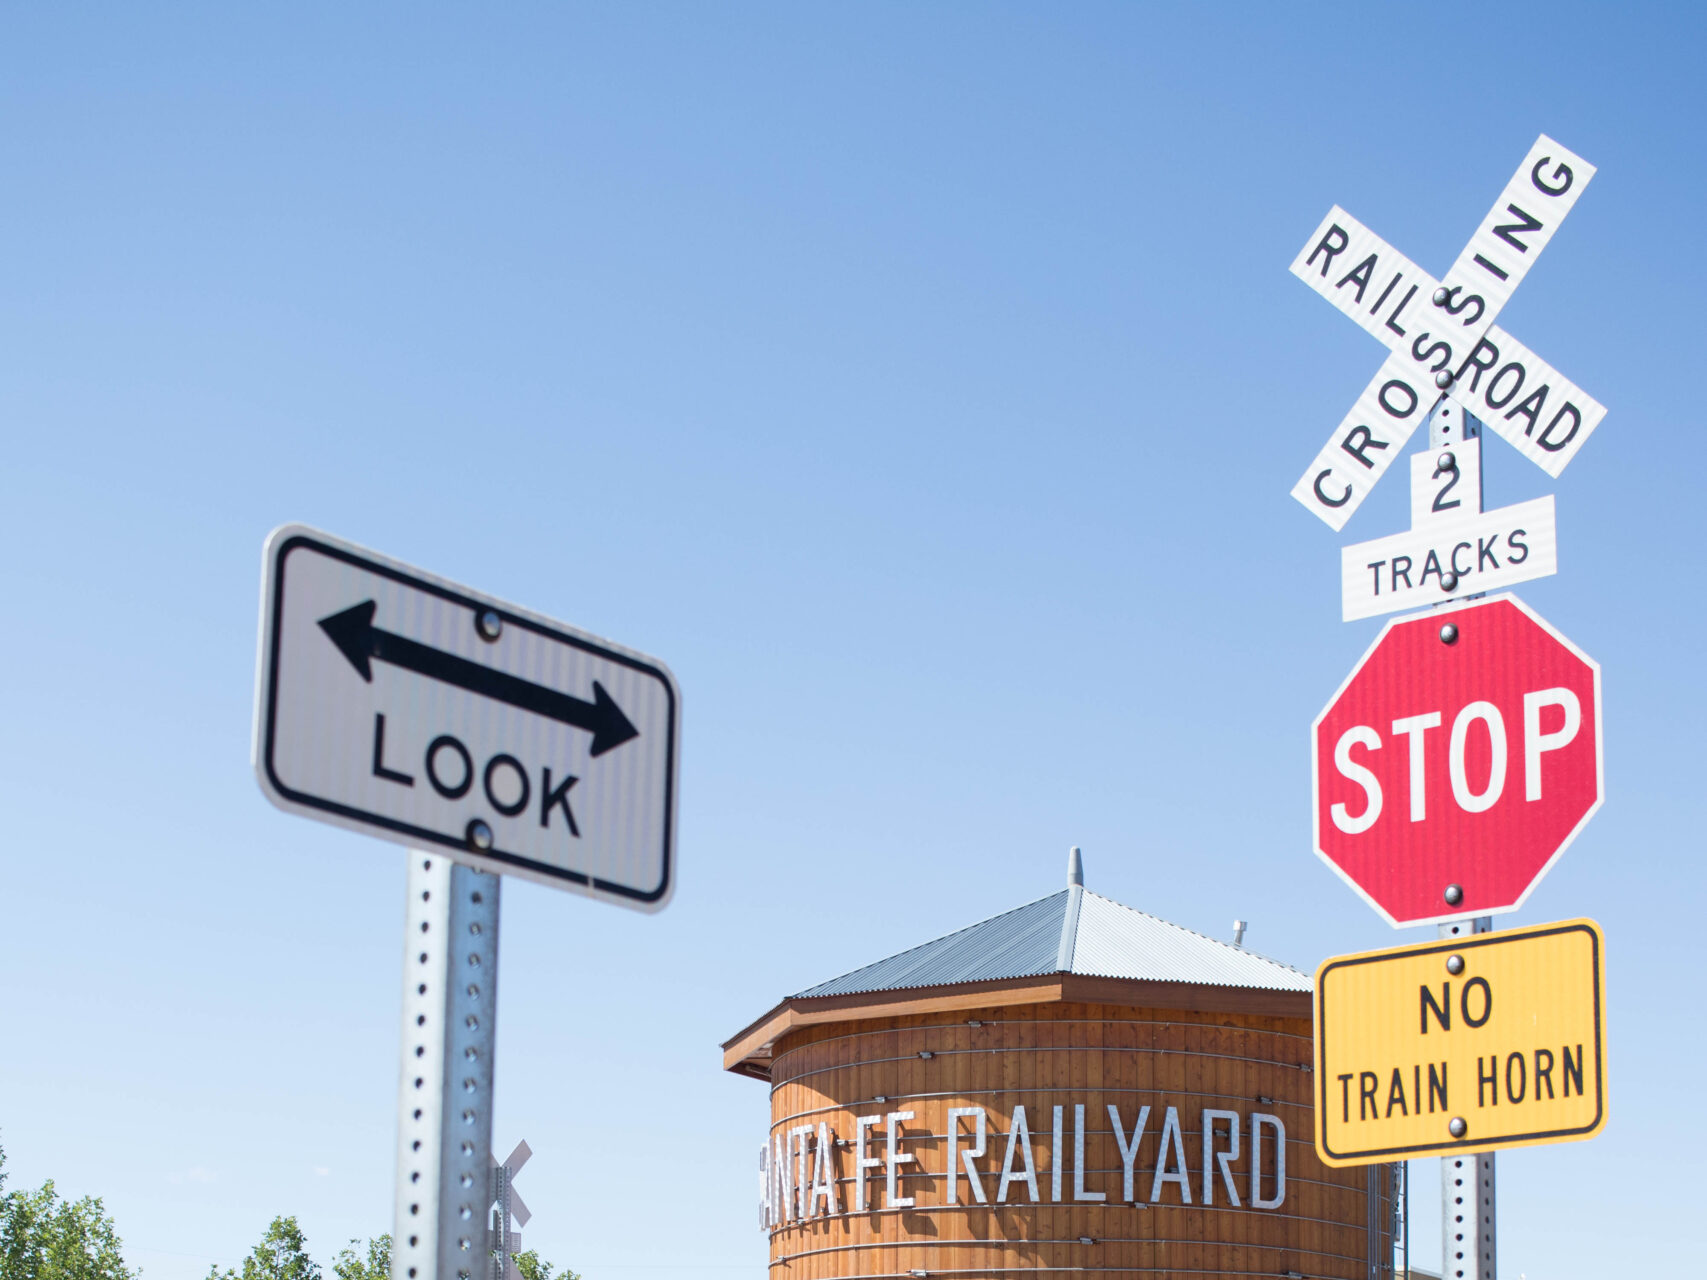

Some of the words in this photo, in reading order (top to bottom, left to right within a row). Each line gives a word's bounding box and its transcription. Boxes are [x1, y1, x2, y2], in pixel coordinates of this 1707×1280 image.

[1306, 224, 1582, 453] RAILROAD
[1313, 156, 1573, 509] CROSSING
[1431, 464, 1461, 513] 2
[1367, 528, 1529, 596] TRACKS
[372, 712, 582, 839] LOOK
[1330, 686, 1582, 835] STOP
[1420, 976, 1492, 1035] NO
[1338, 1061, 1448, 1123] TRAIN
[1478, 1044, 1584, 1108] HORN
[856, 1110, 916, 1211] FE
[947, 1104, 1287, 1209] RAILYARD
